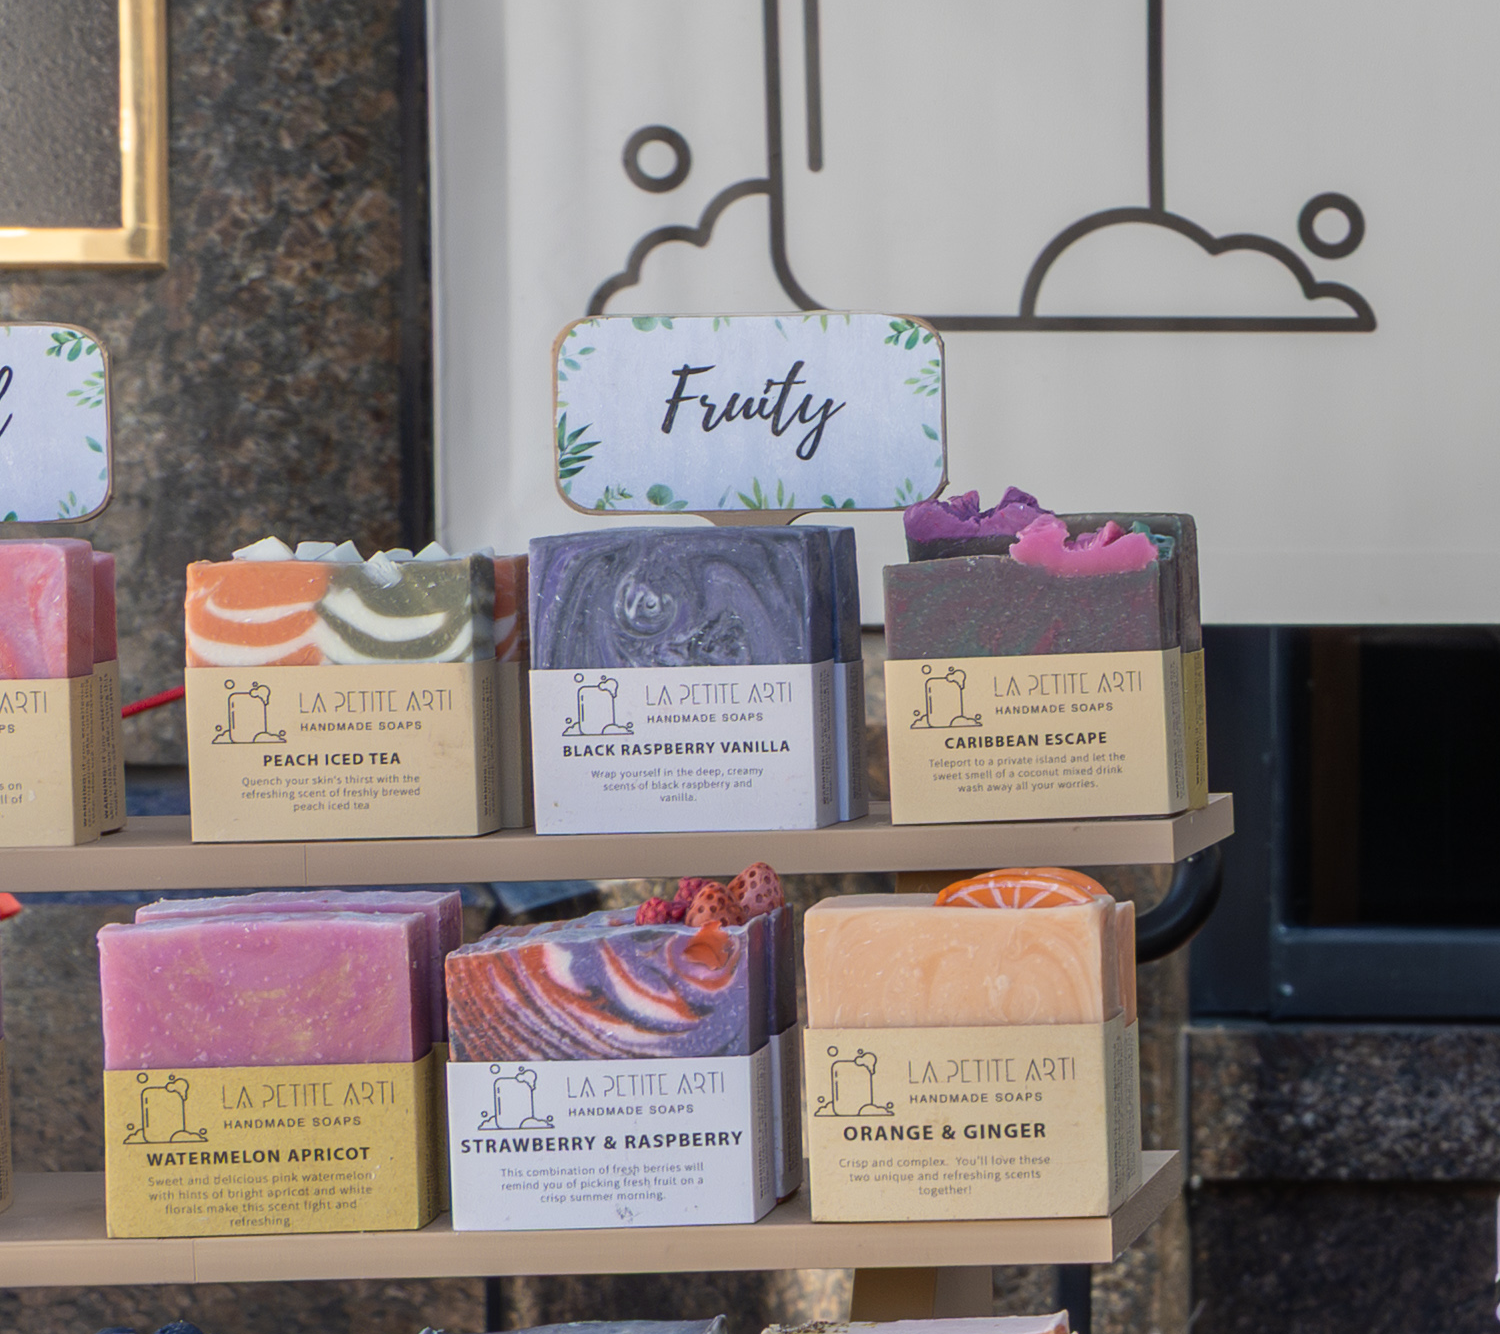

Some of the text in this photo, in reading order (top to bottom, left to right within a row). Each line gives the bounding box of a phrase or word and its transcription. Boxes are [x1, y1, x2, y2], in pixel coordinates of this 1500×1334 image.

[660, 360, 847, 461] Fruity
[563, 740, 790, 758] BLACK RASPBERRY VANILLA
[944, 731, 1107, 750] CARIBBEAN ESCAPE
[263, 752, 401, 767] PEACH ICED TEA
[460, 1130, 743, 1154] STRAWBERRY & RASPBERRY
[843, 1122, 1046, 1142] ORANGE & GINGER
[146, 1146, 371, 1167] WATERMELON APRICOT
